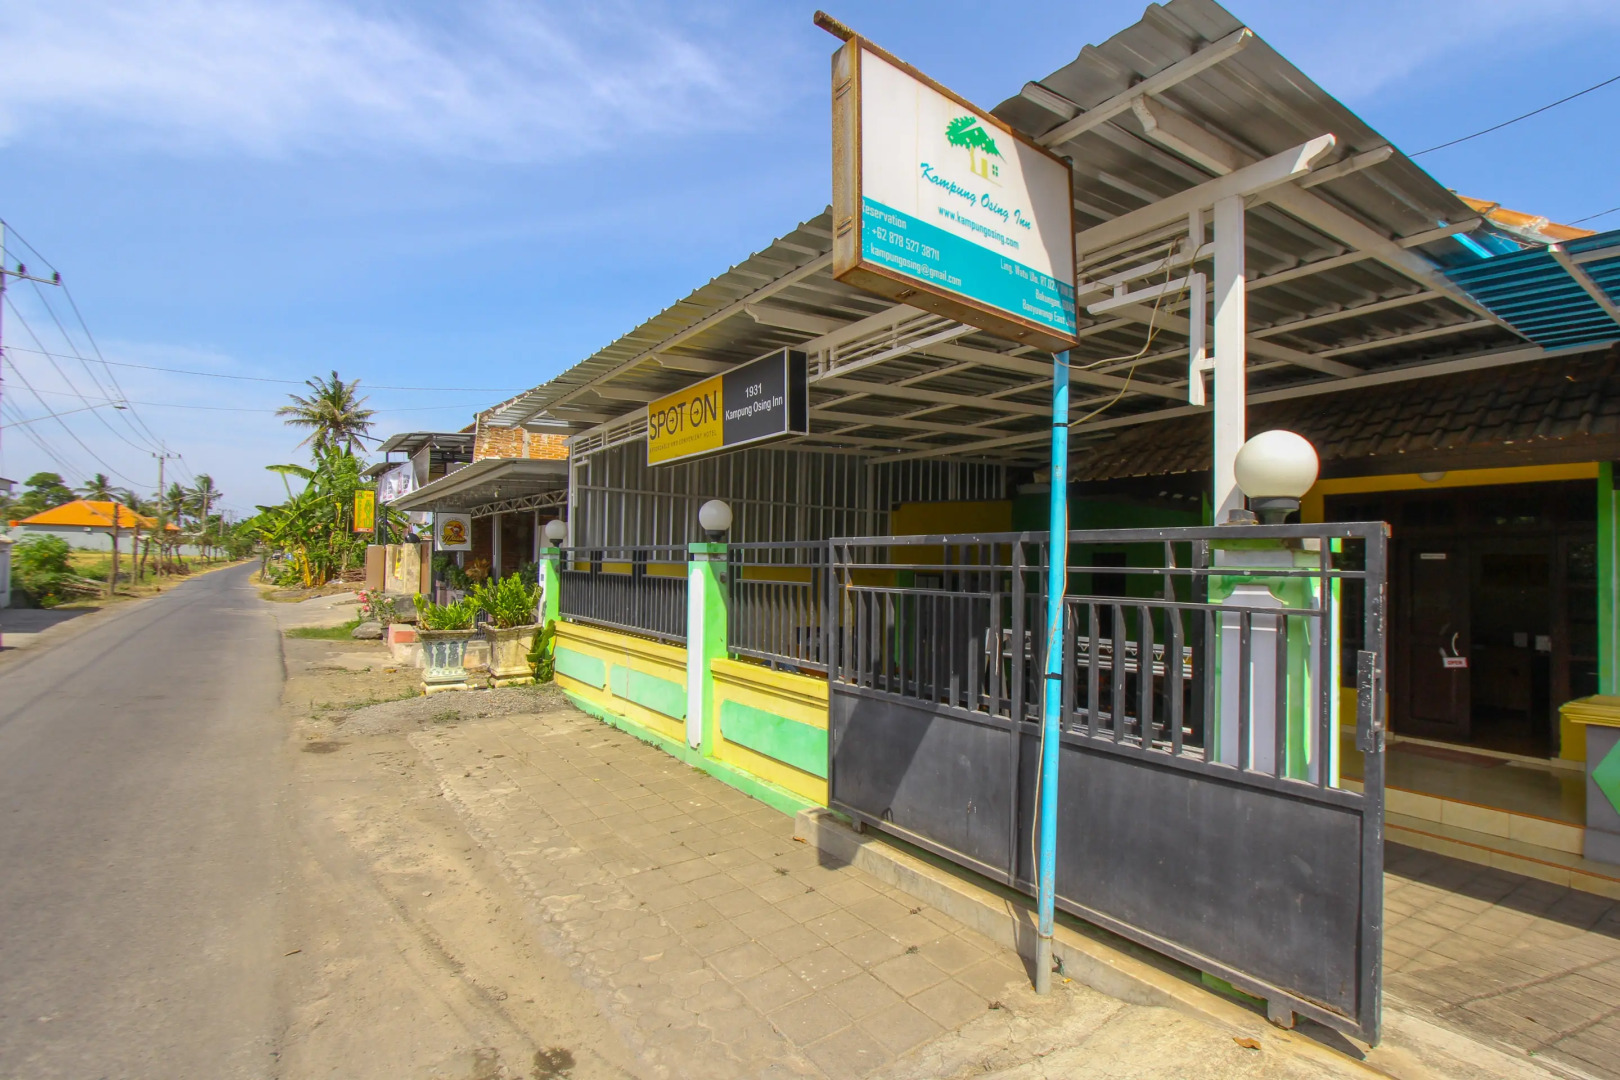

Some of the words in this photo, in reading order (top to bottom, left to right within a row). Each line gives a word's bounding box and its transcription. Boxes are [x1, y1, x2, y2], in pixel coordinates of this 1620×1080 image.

[920, 162, 977, 207] Kampung
[980, 193, 1009, 223] Osing
[1014, 208, 1031, 230] Inn
[872, 226, 887, 241] +62
[889, 231, 904, 247] 878
[906, 238, 920, 253] 527
[922, 244, 940, 261] 38711
[938, 205, 1020, 250] www.kampungosing.com
[870, 242, 962, 287] kampungosing@gmail.com
[1054, 311, 1065, 325] East
[725, 405, 752, 421] Kampung
[753, 399, 771, 412] Osing
[772, 395, 783, 407] Inn
[745, 382, 762, 398] 1931
[650, 401, 687, 440] SPOT
[690, 390, 717, 427] ON
